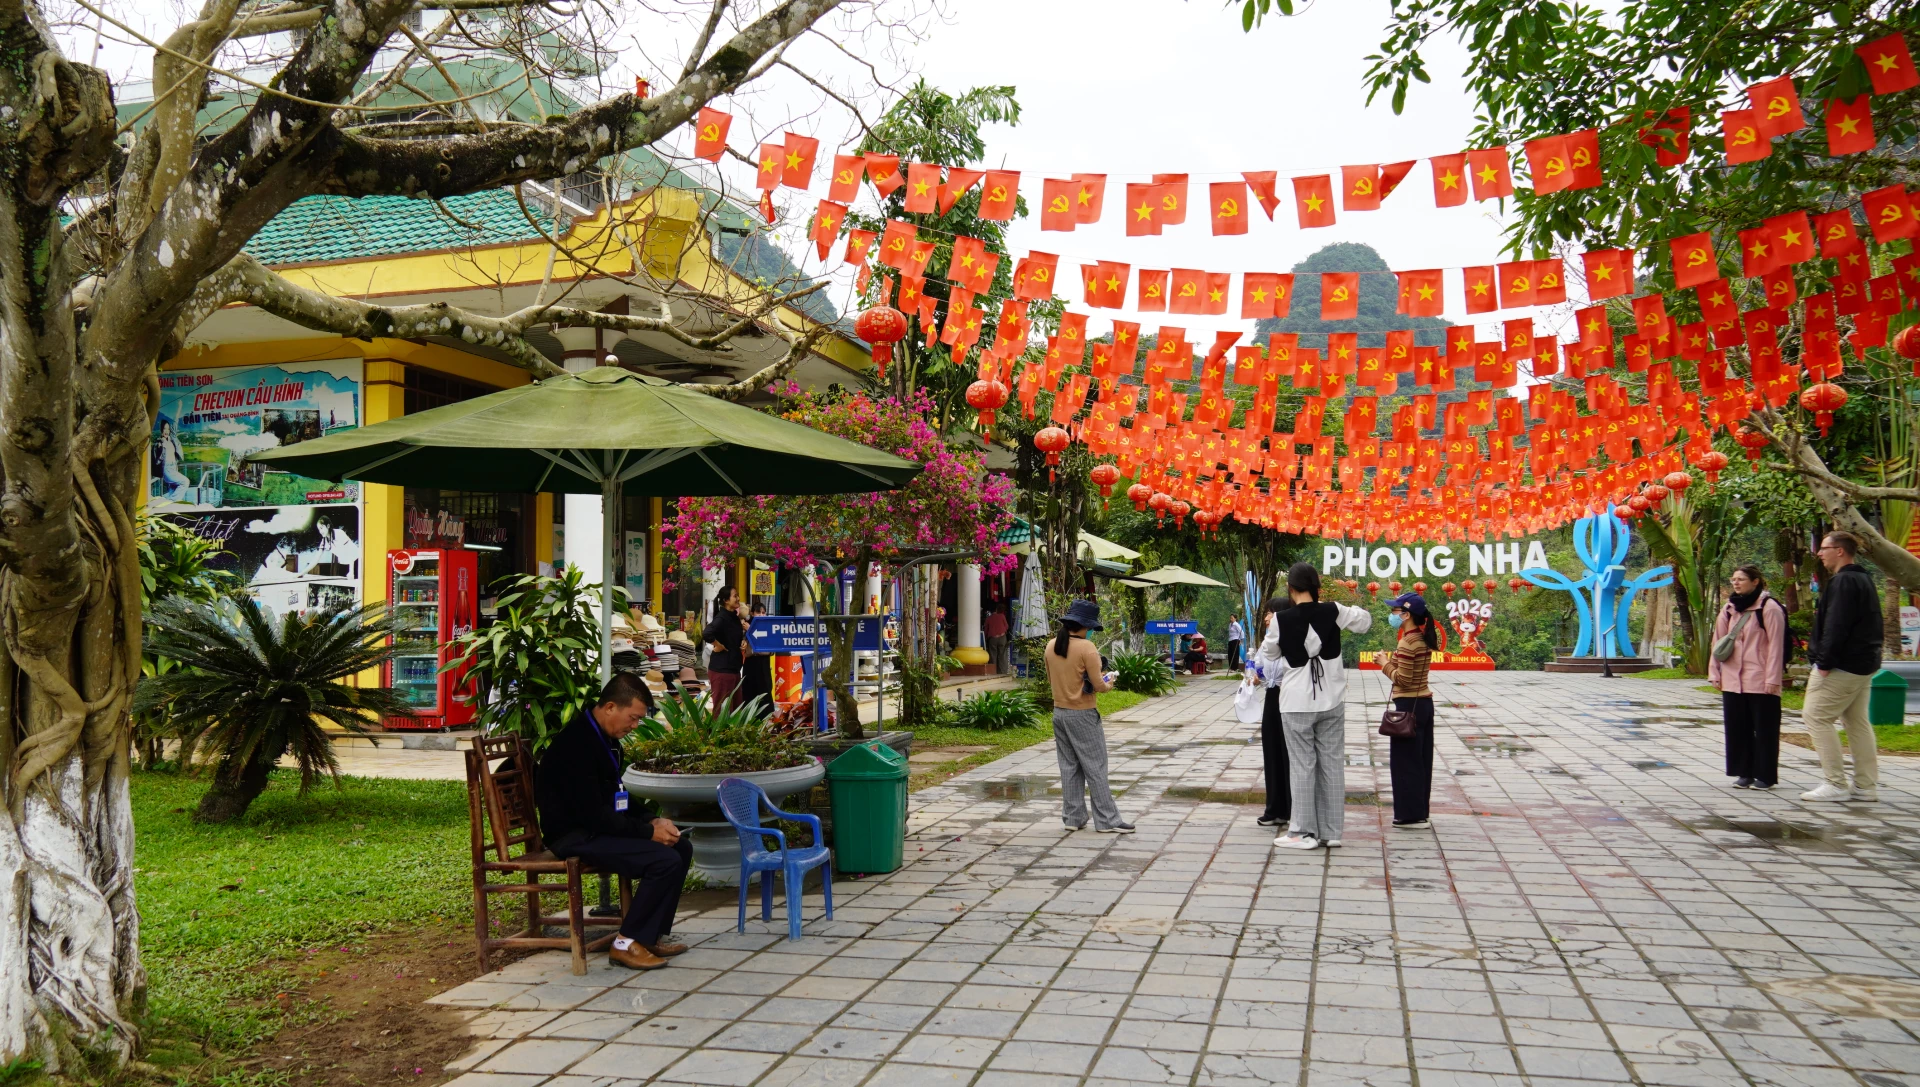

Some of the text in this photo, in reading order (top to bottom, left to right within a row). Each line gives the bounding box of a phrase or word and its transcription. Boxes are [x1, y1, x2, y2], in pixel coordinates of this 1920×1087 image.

[177, 374, 194, 387] TIÊN
[196, 374, 213, 386] SƠN
[245, 378, 273, 406] CẦU
[202, 410, 221, 423] TIÊN
[174, 514, 240, 540] Hotel
[1322, 540, 1550, 578] PHONG NHA
[1445, 599, 1493, 619] 2026
[772, 621, 815, 634] PHÒNG
[783, 637, 815, 645] TICKET
